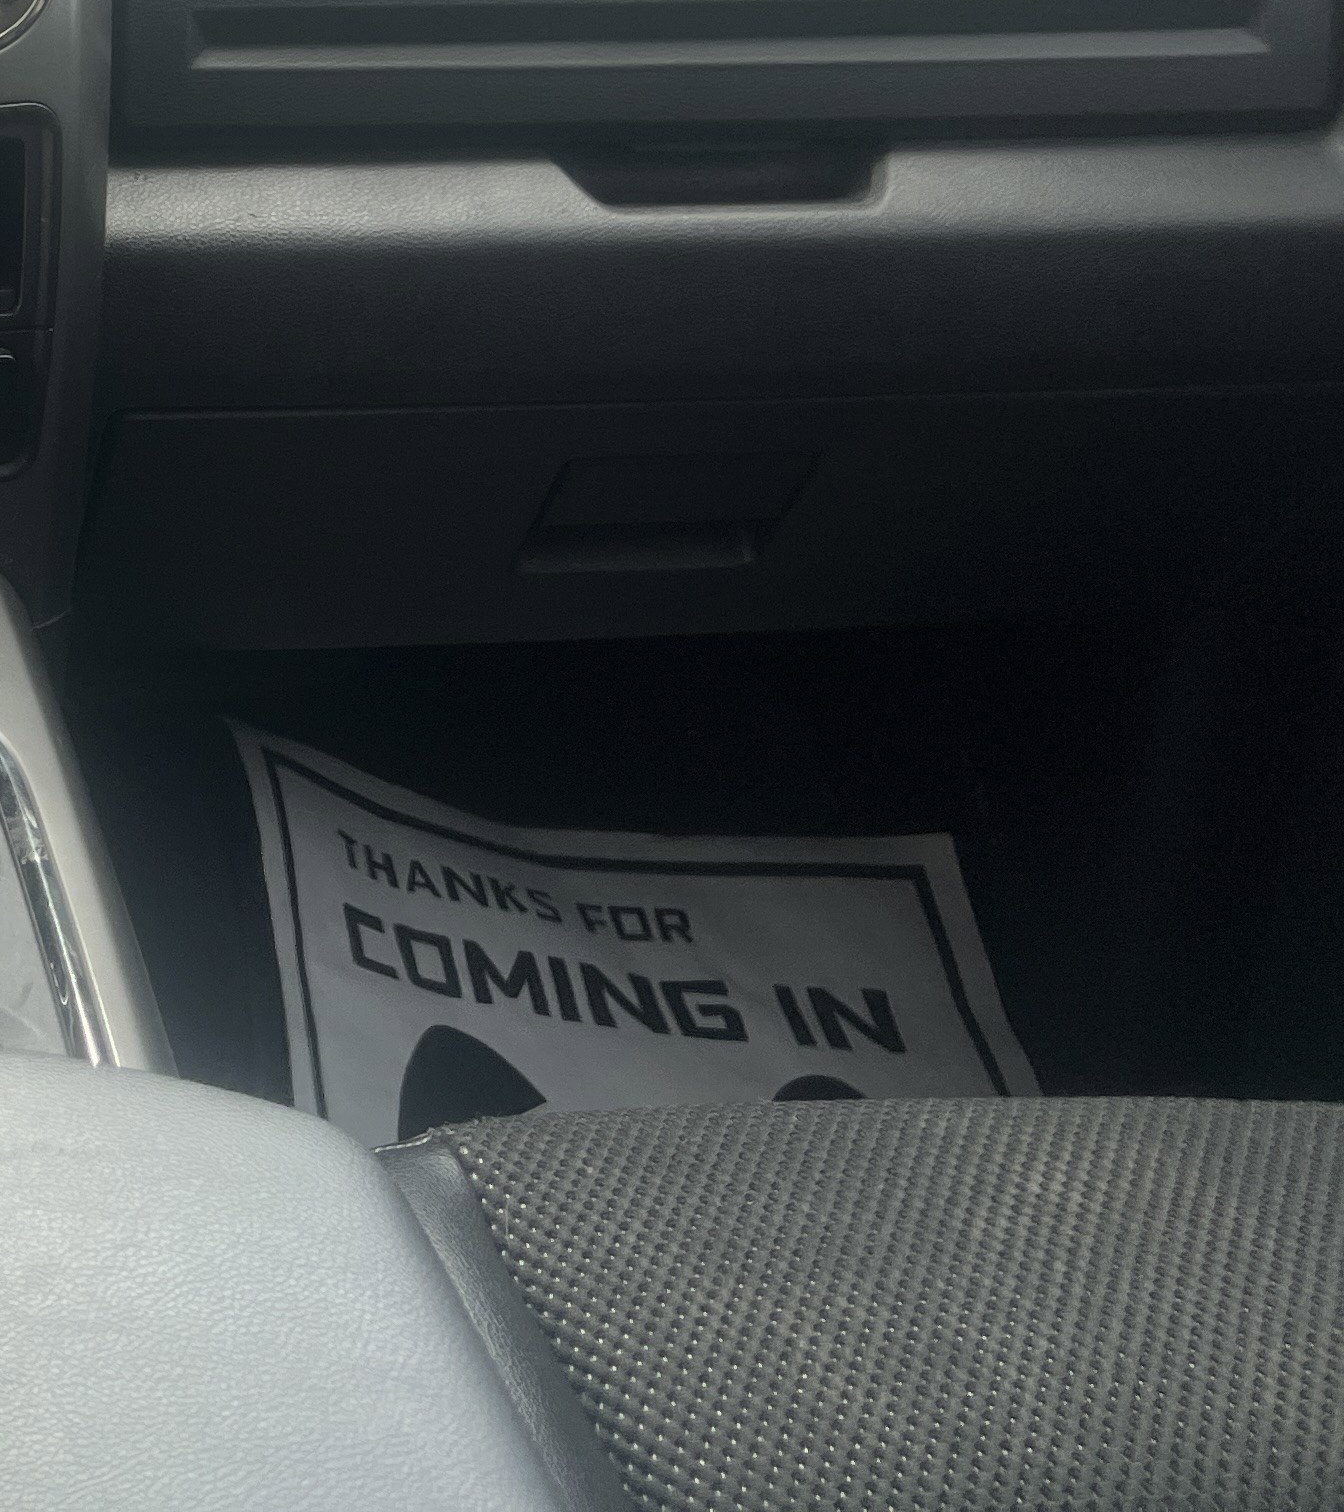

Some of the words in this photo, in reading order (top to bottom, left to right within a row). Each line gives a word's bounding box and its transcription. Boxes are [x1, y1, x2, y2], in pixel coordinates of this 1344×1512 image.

[337, 829, 562, 924] THANKS
[575, 901, 694, 944] FOR
[342, 902, 750, 1043] COMING
[771, 983, 908, 1055] IN
